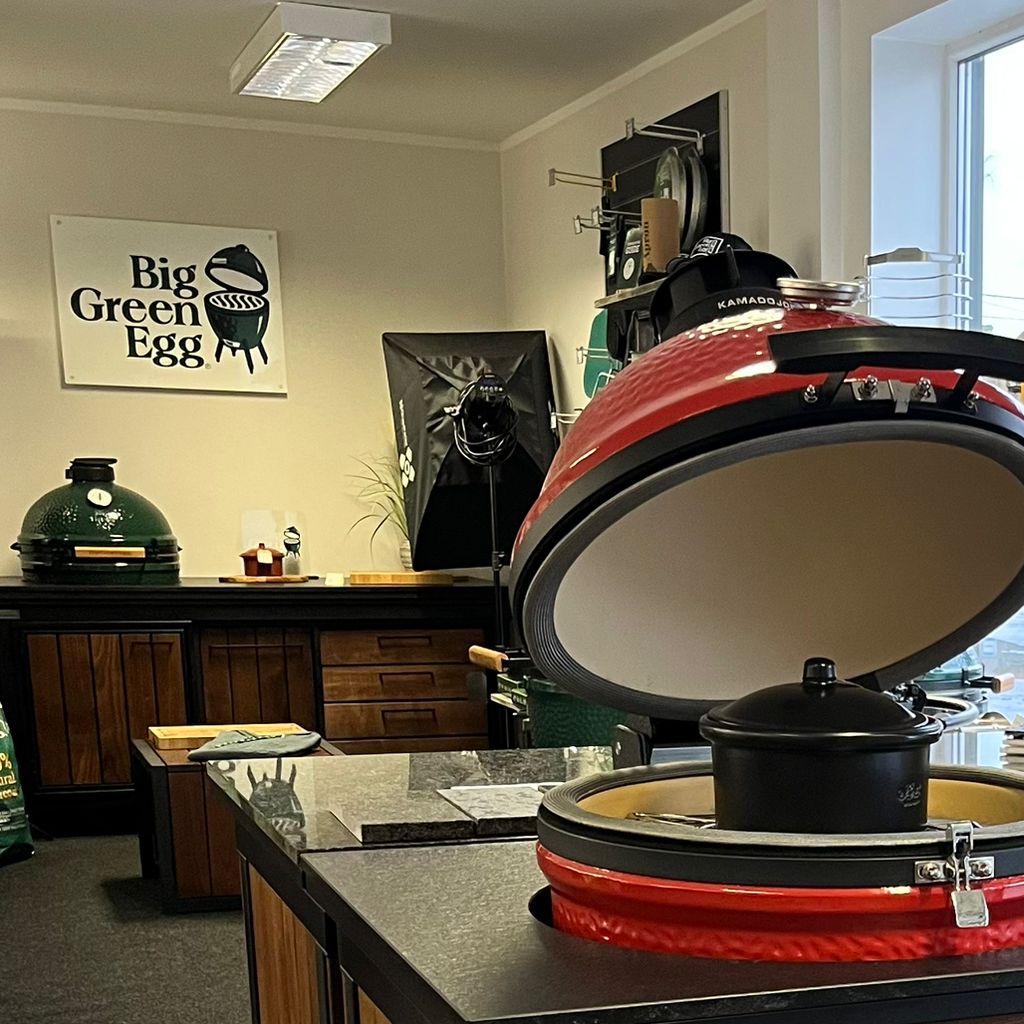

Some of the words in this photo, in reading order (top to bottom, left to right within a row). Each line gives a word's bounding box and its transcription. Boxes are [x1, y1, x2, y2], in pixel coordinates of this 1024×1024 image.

[129, 254, 199, 300] Big
[70, 287, 202, 326] Green
[717, 296, 794, 311] KAMADOJO
[126, 325, 204, 369] Egg
